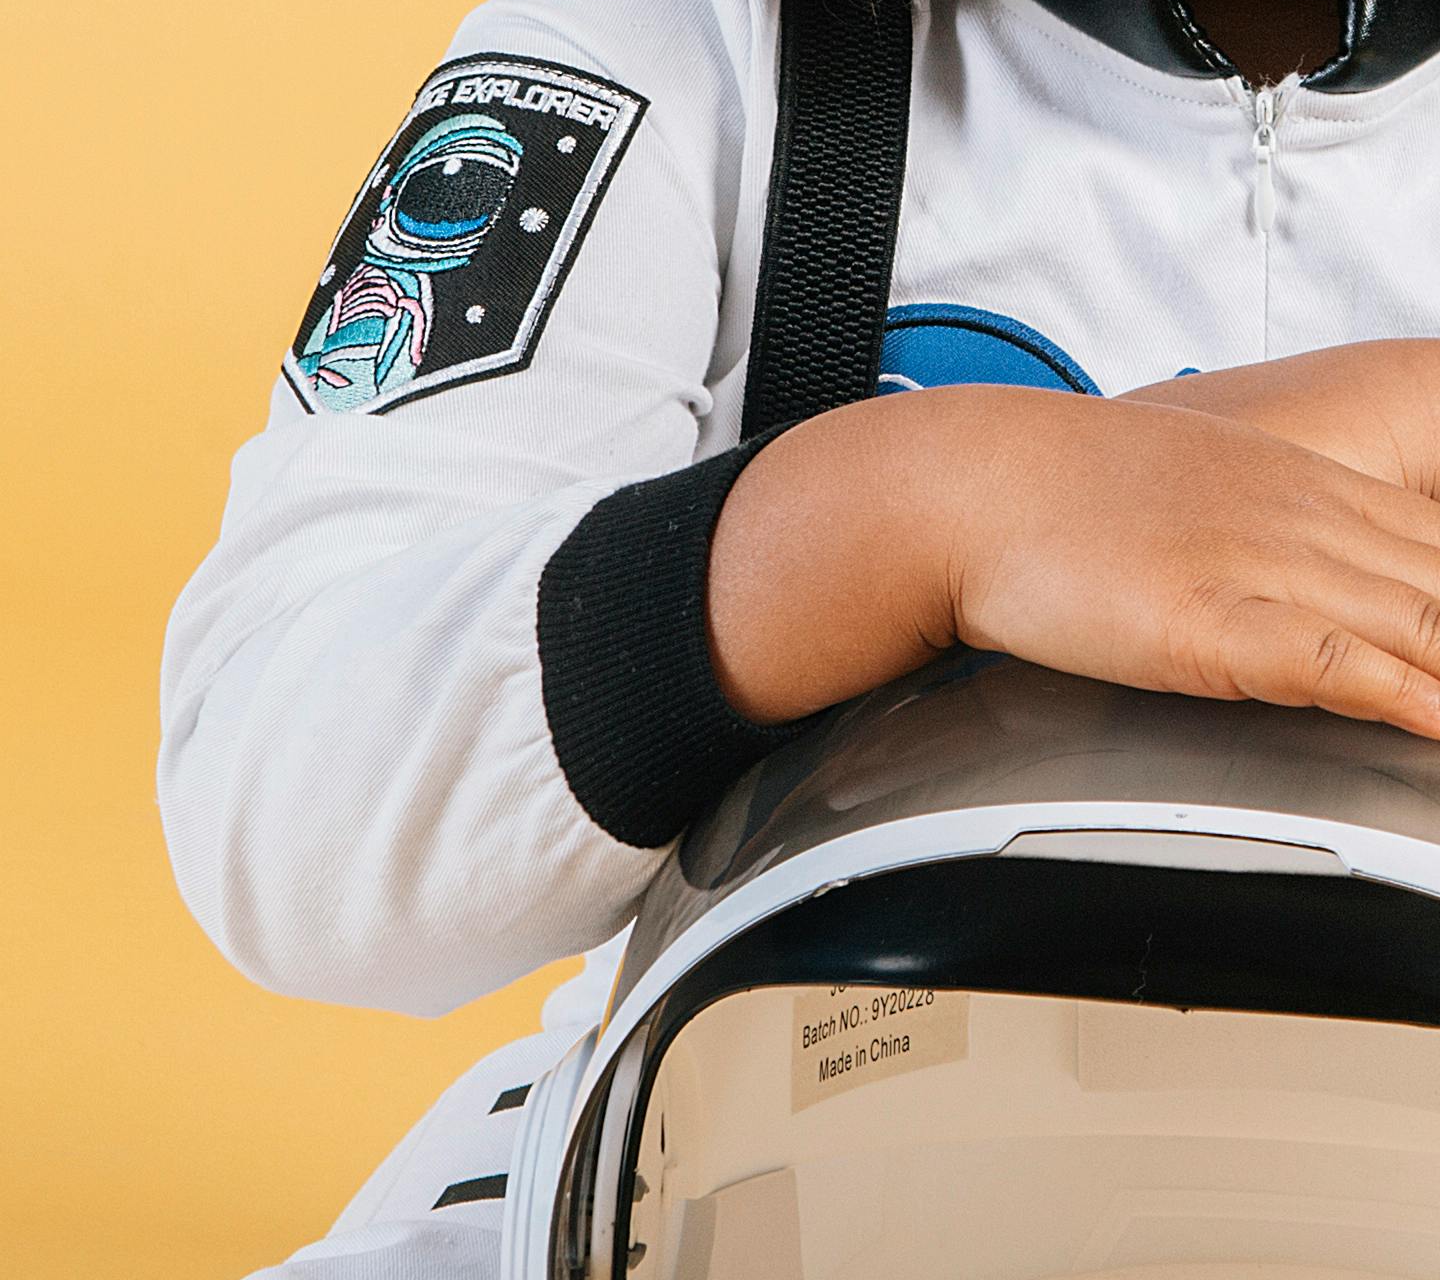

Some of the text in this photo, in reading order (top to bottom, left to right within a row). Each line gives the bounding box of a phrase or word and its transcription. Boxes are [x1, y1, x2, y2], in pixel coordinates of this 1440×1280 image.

[450, 75, 617, 131] EXPLORER
[802, 1015, 836, 1049] Batch
[818, 1033, 911, 1083] Made in China
